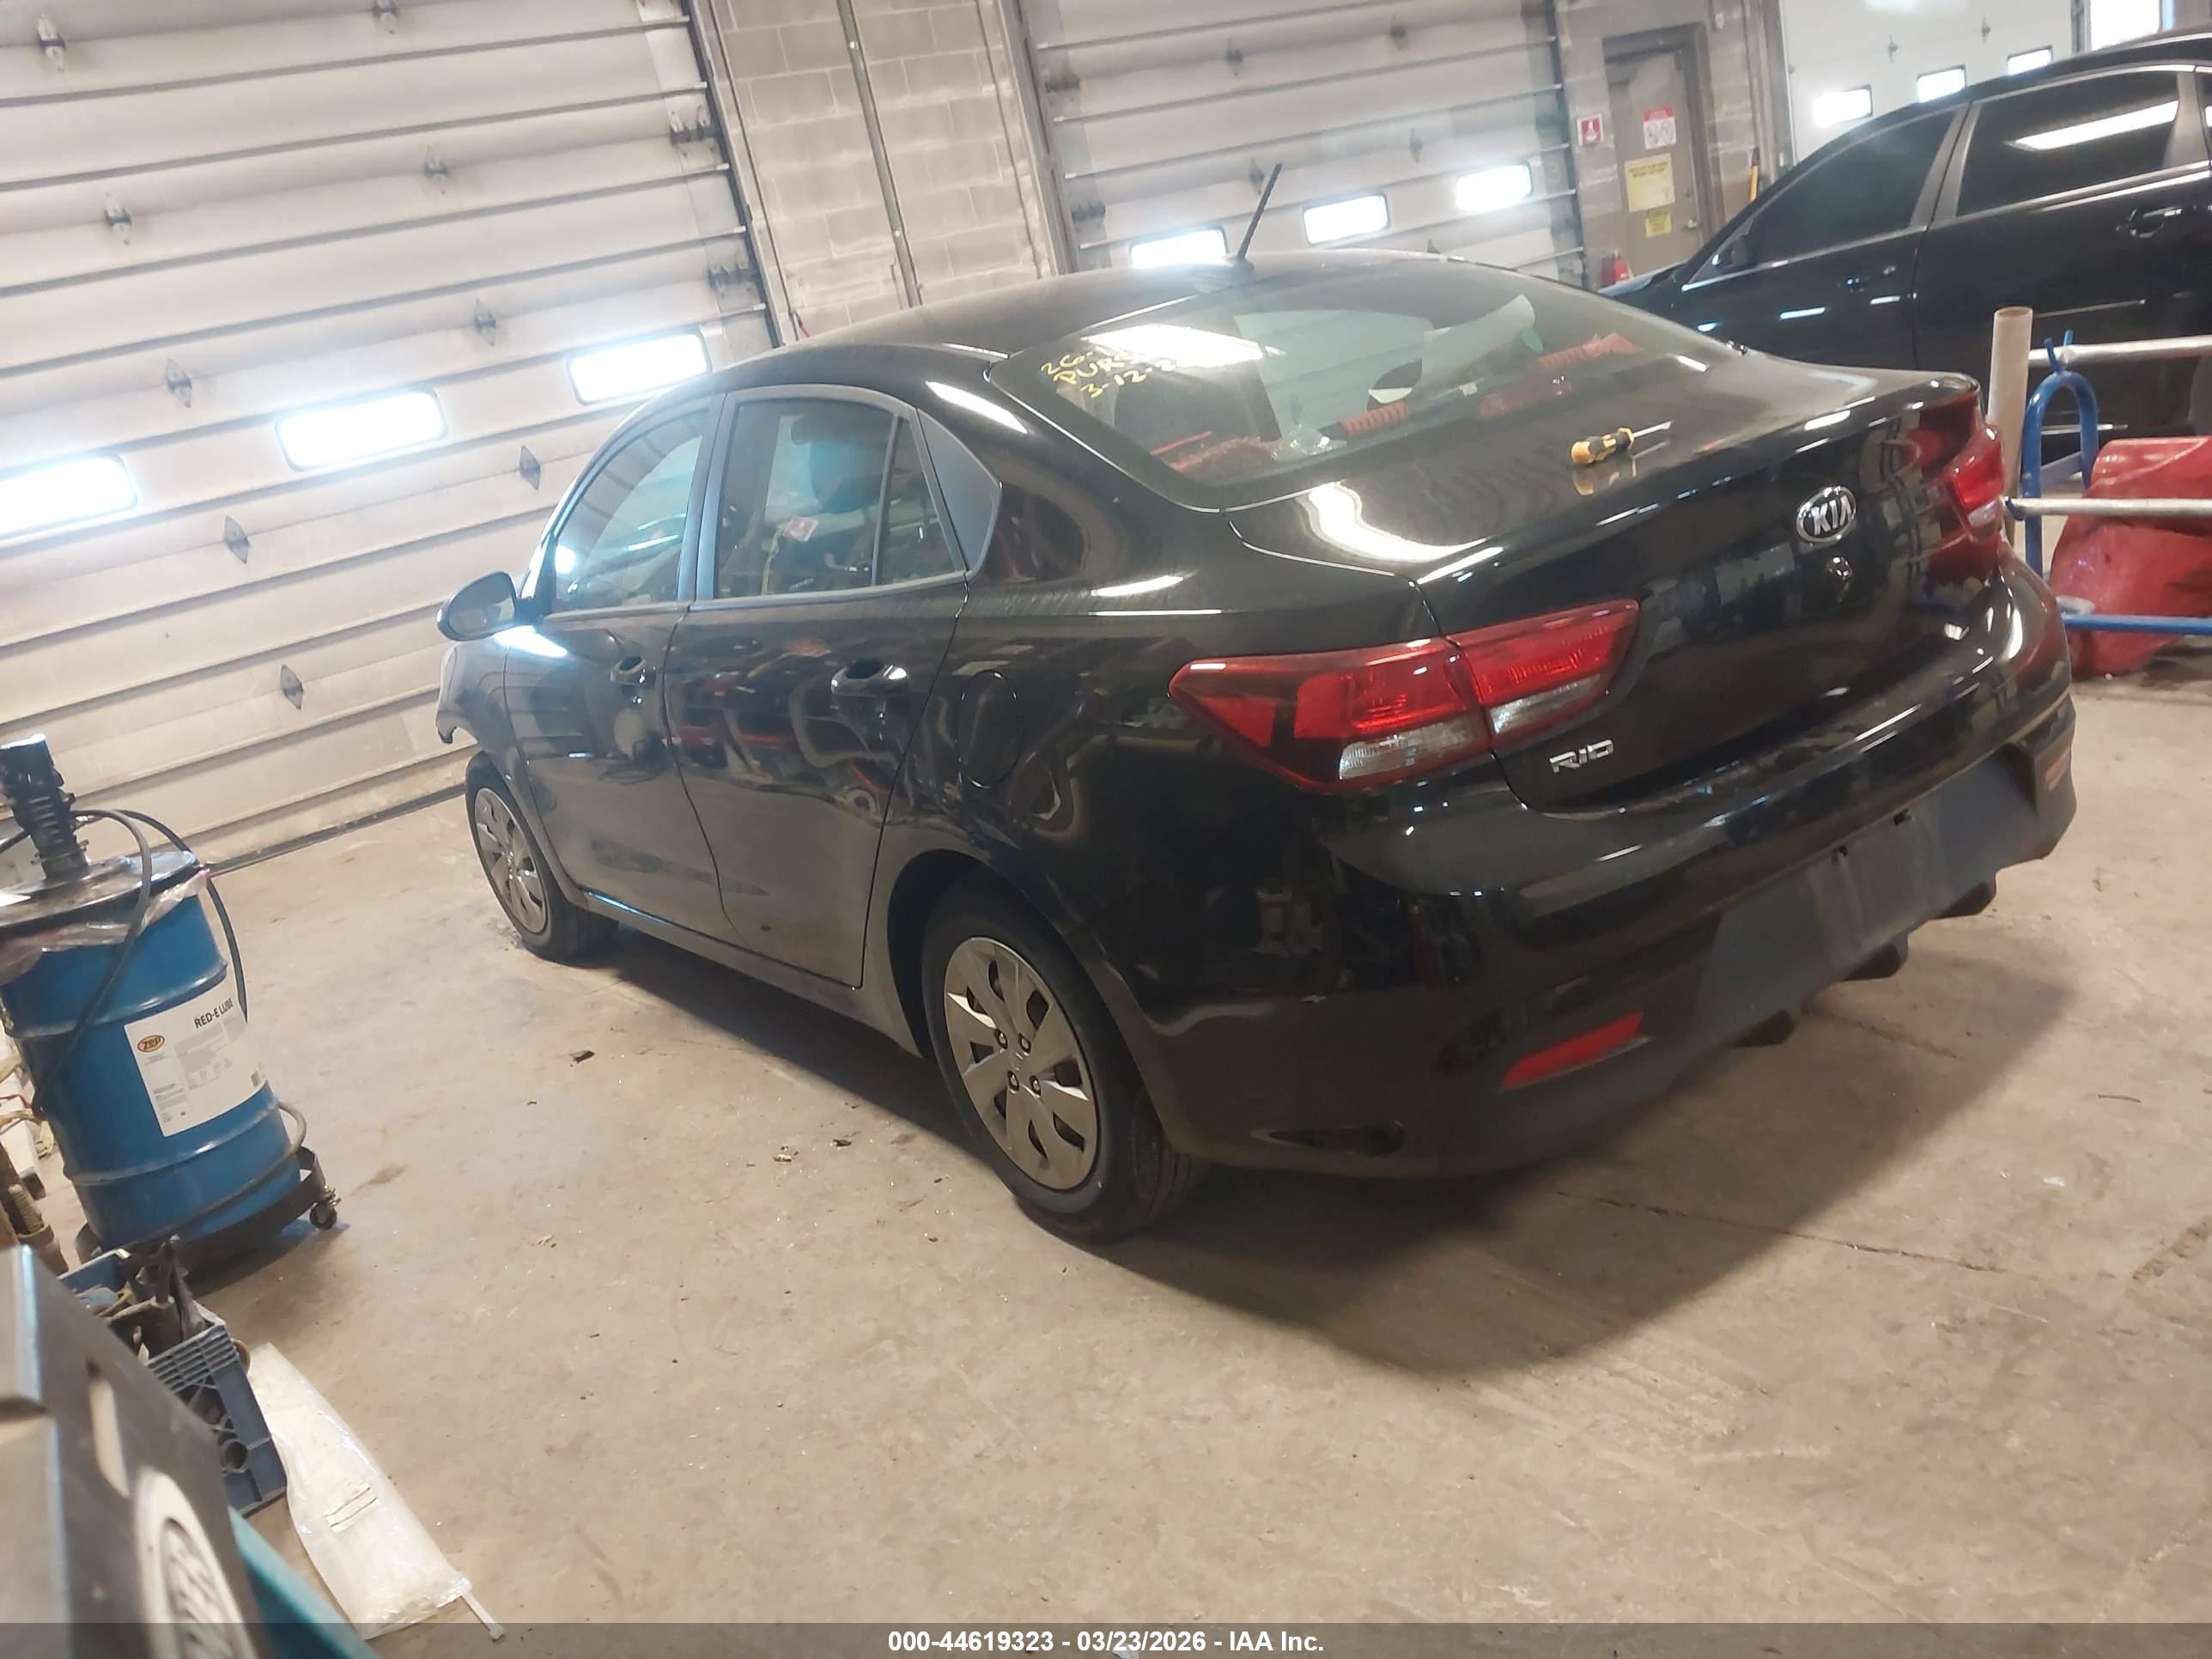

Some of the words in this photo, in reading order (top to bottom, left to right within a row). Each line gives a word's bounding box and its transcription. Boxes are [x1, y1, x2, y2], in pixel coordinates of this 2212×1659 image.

[1810, 495, 1853, 537] KIA
[1549, 739, 1614, 774] RIO
[194, 1008, 221, 1030] RED-E
